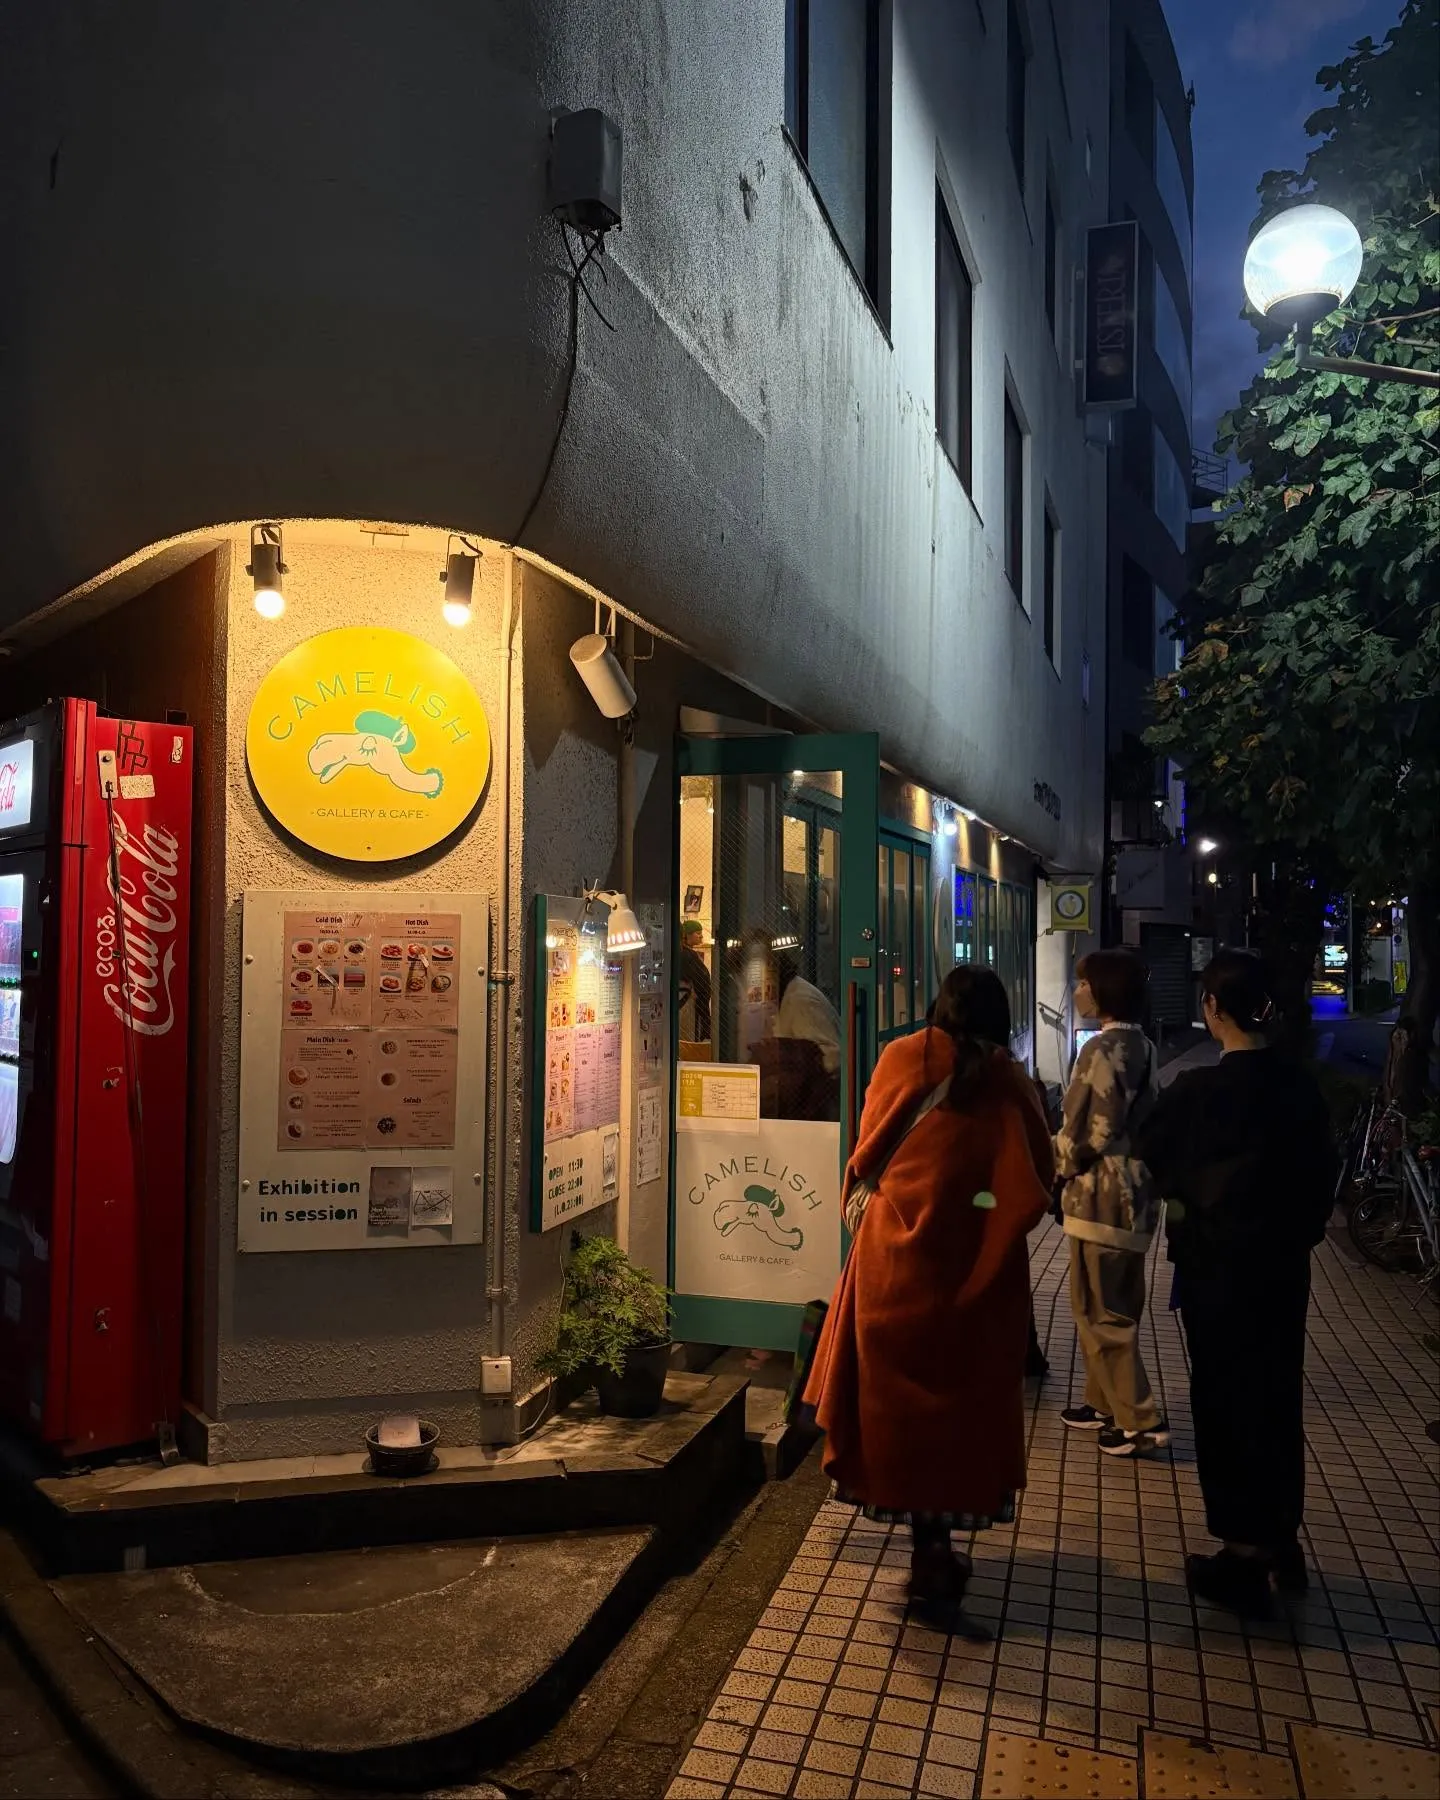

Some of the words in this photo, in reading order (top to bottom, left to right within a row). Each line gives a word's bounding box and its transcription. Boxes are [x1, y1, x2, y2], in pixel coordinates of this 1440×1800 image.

[268, 671, 471, 744] CAMELISH
[378, 808, 387, 819] &
[104, 809, 178, 1036] Coca-Cola
[548, 1165, 564, 1181] OPEN
[568, 1157, 584, 1173] 11:30
[258, 1179, 361, 1196] Exhibition
[548, 1183, 566, 1200] CLOSE
[567, 1175, 583, 1191] 22:00
[688, 1156, 822, 1211] CAMELISH
[260, 1207, 278, 1223] in
[284, 1205, 358, 1222] session
[759, 1256, 766, 1264] &
